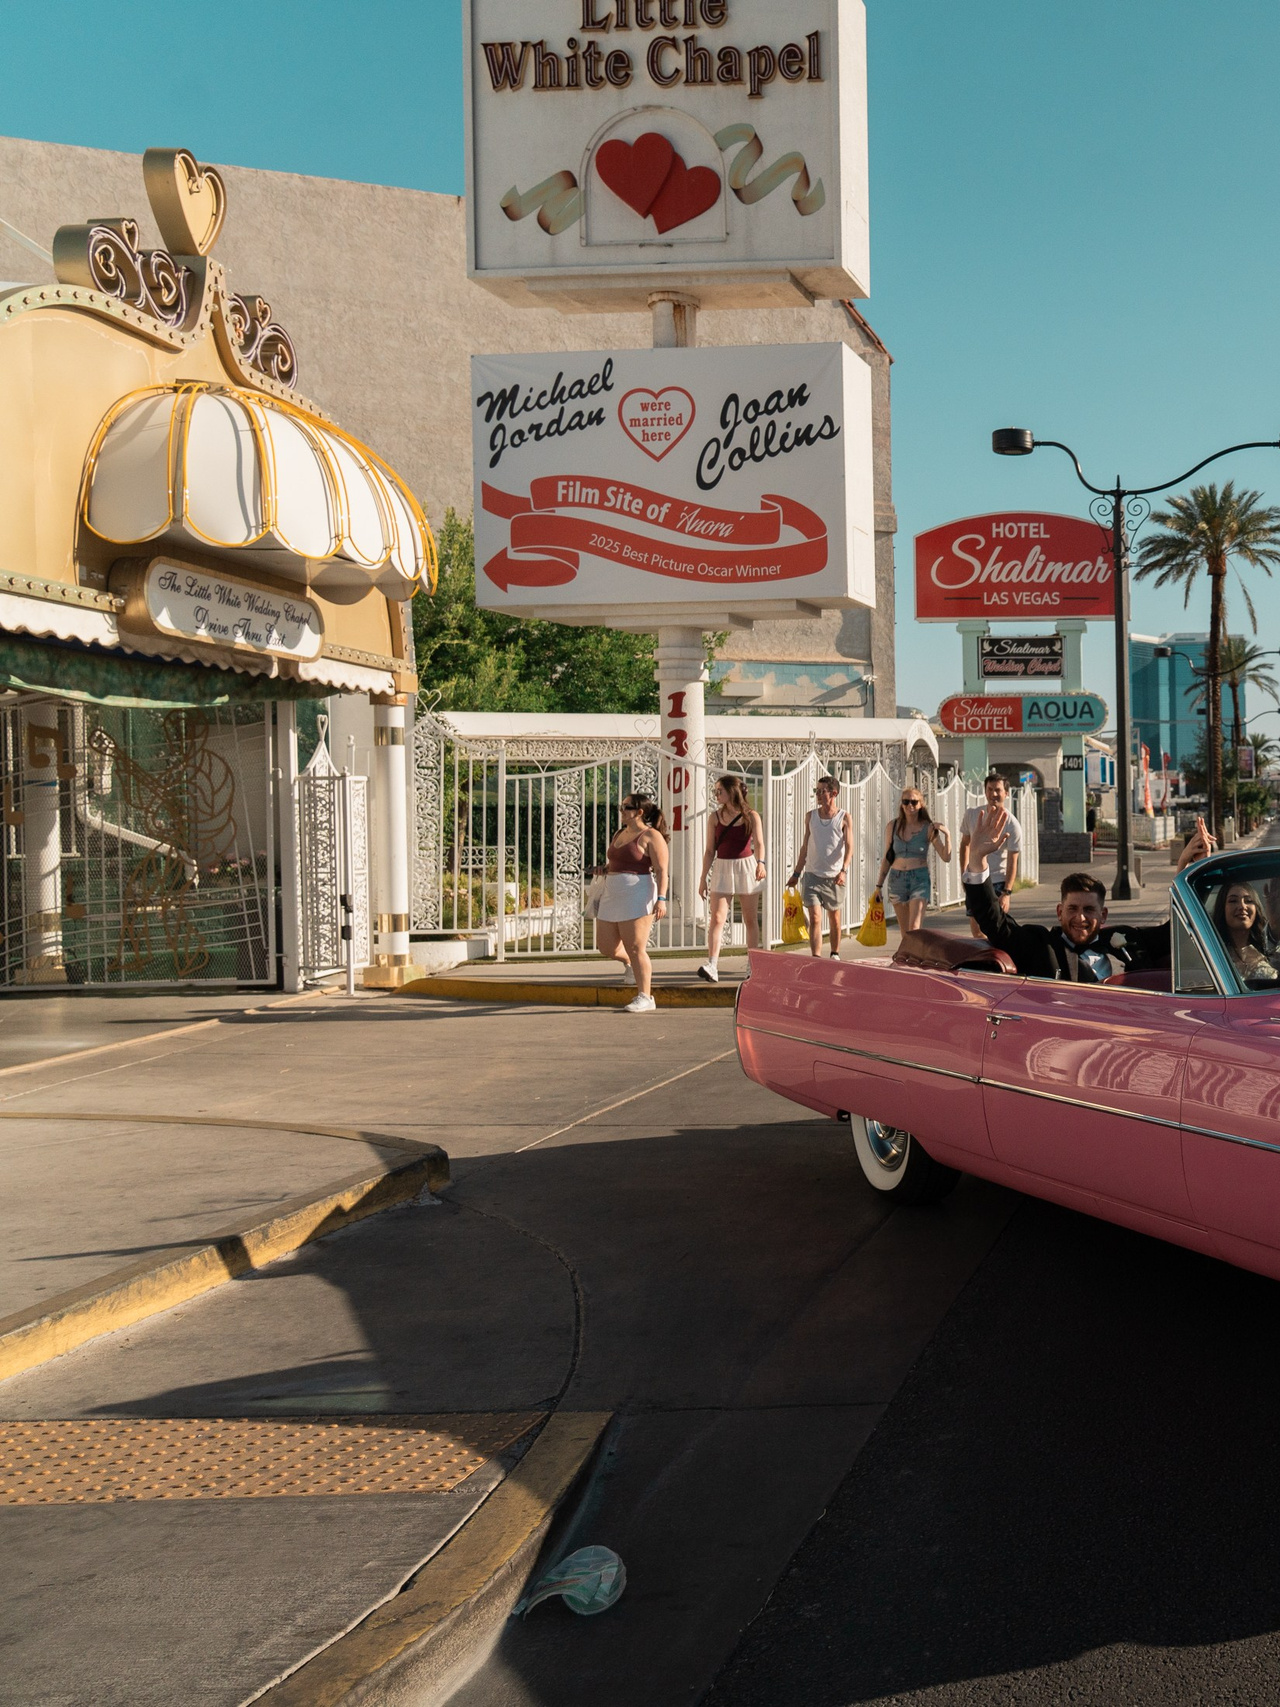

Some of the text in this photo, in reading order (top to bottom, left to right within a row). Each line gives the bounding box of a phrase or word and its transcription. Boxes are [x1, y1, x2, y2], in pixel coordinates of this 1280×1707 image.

[580, 0, 728, 33] Little
[481, 30, 824, 98] White Chapel
[477, 357, 614, 423] Michael
[640, 400, 671, 412] were
[629, 413, 683, 427] married
[720, 382, 811, 449] Joan
[489, 406, 605, 468] Jordan
[641, 429, 671, 442] here
[695, 414, 841, 491] Collins
[557, 481, 600, 505] Film
[604, 486, 643, 515] Site
[647, 501, 671, 523] of
[992, 522, 1050, 539] HOTEL
[588, 532, 782, 577] 2025 Best Picture Oscar Winner
[931, 534, 1112, 589] Shalimar
[158, 571, 312, 629] The Little White Wedding Chapel
[983, 591, 1060, 605] LAS VEGAS
[193, 605, 286, 647] Drive Thru Exit
[993, 640, 1051, 655] Shalimar
[984, 657, 1061, 676] Wedding Chapel
[953, 699, 1013, 718] Shalimar
[953, 717, 1013, 731] HOTEL
[1028, 701, 1094, 721] AQUA
[666, 691, 690, 831] 1301
[1063, 757, 1083, 769] 1401
